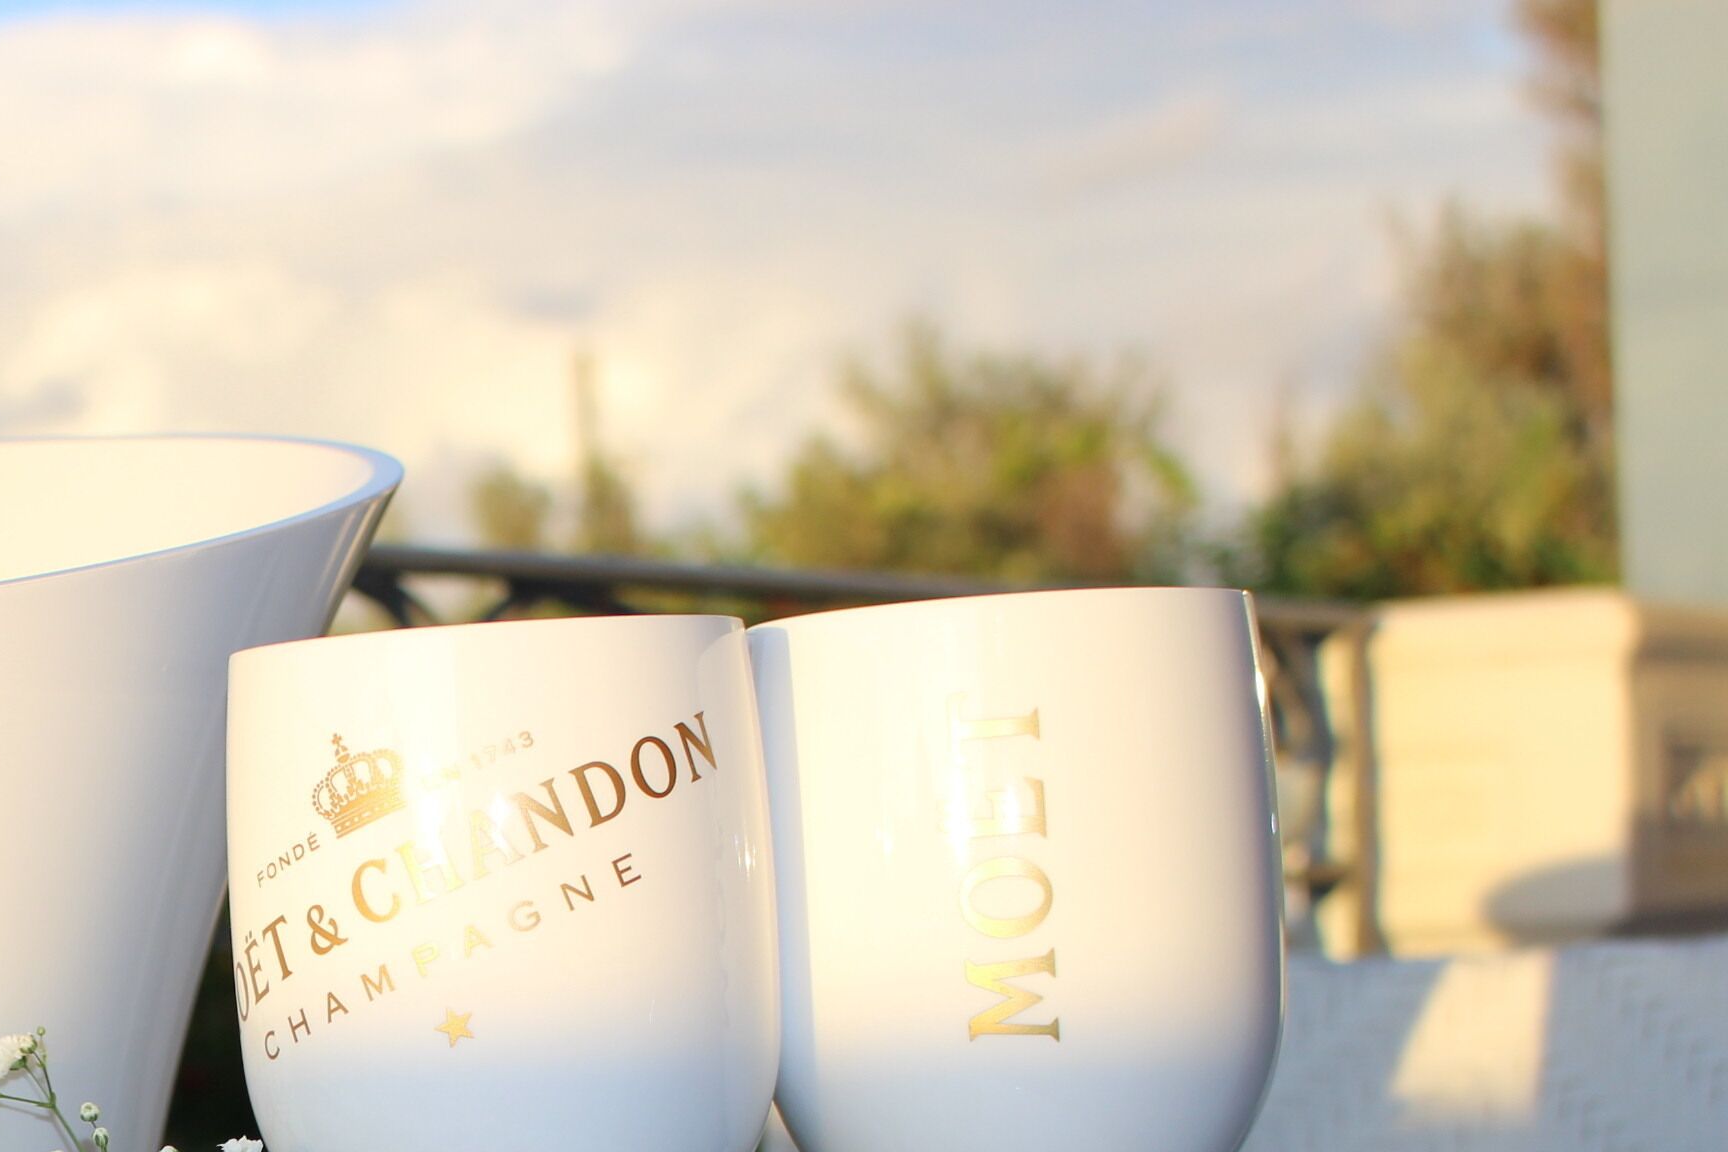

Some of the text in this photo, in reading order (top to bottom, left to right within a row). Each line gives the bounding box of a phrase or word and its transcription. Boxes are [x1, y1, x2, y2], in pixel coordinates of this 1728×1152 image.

[235, 710, 719, 1022] OËT & CHANDON
[264, 852, 644, 1060] CHAMPAGNE
